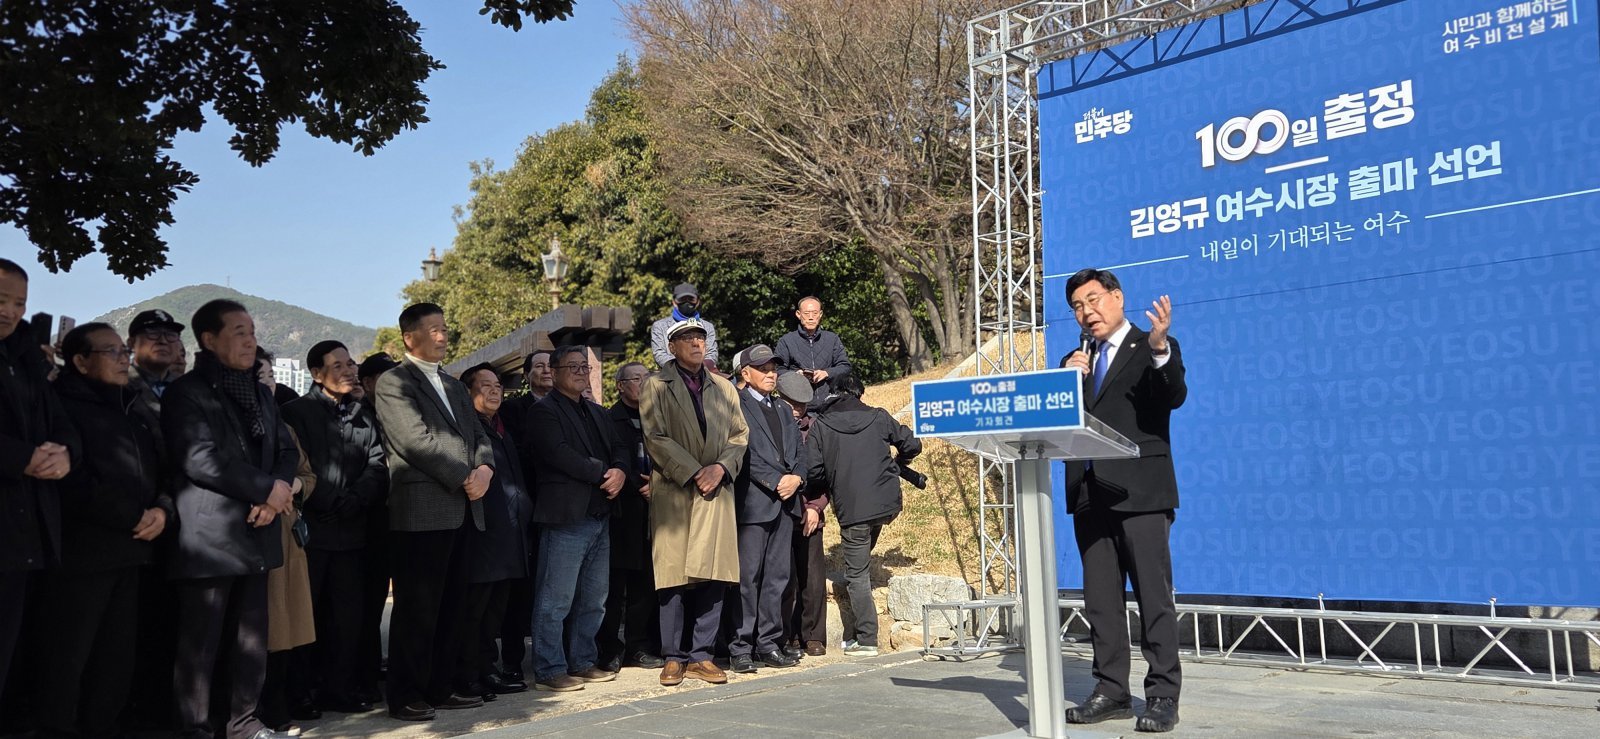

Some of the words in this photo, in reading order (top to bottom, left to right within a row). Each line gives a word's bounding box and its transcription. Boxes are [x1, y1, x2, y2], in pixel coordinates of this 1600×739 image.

[1442, 11, 1493, 37] 시민과
[1496, 0, 1568, 24] 함께하는
[1074, 109, 1133, 144] 민주당
[1196, 109, 1319, 168] 100일
[1323, 79, 1415, 141] 출정
[1130, 196, 1210, 239] 김영규
[1215, 174, 1338, 223] 여수시장
[1348, 157, 1418, 201] 출마
[1428, 140, 1502, 186] 선언
[1199, 233, 1259, 263] 내일이
[1268, 221, 1355, 252] 기대되는
[1363, 210, 1411, 237] 여수
[918, 400, 956, 418] 김영규
[957, 396, 1011, 415] 여수시장
[1013, 393, 1042, 412] 출마
[1045, 391, 1075, 410] 선언
